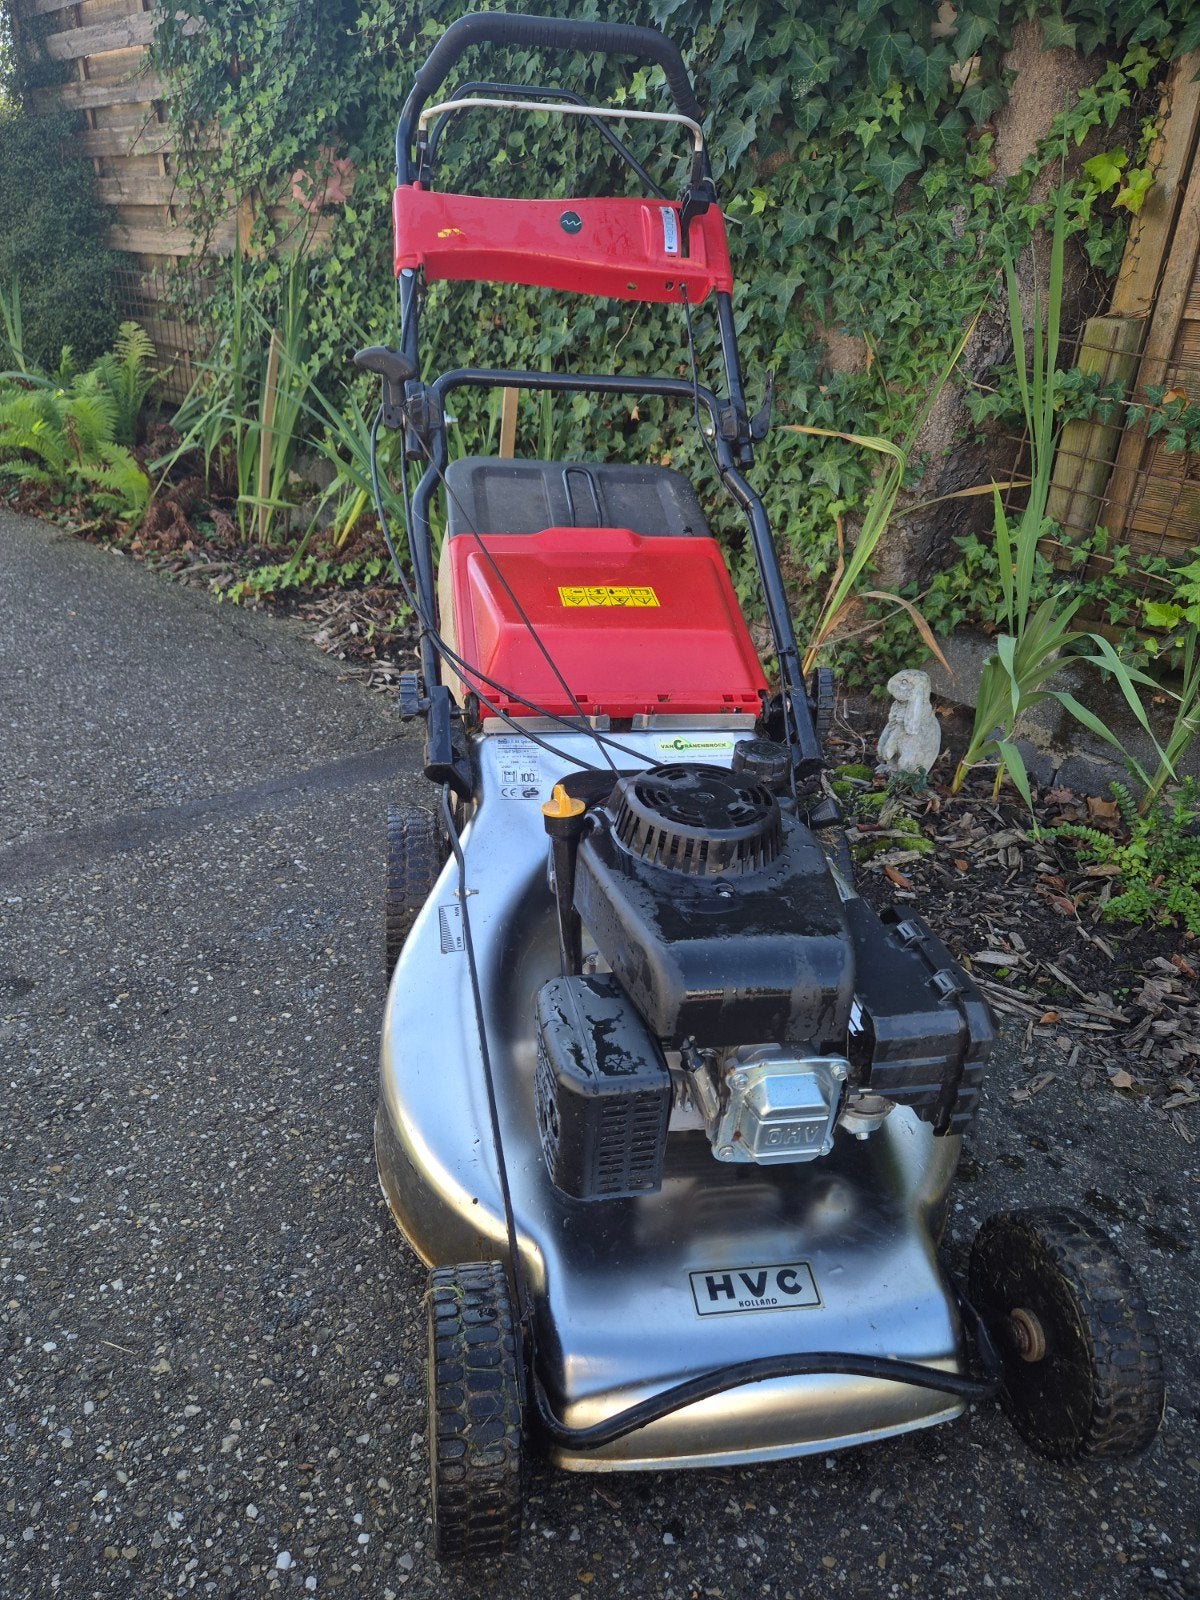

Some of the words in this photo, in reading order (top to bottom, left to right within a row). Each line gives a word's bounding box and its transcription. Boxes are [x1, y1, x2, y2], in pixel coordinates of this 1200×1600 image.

[520, 772, 535, 783] 100
[501, 787, 517, 798] CE
[765, 1126, 820, 1146] OHV
[705, 1268, 803, 1301] HVC
[738, 1297, 778, 1308] HOLLAND
